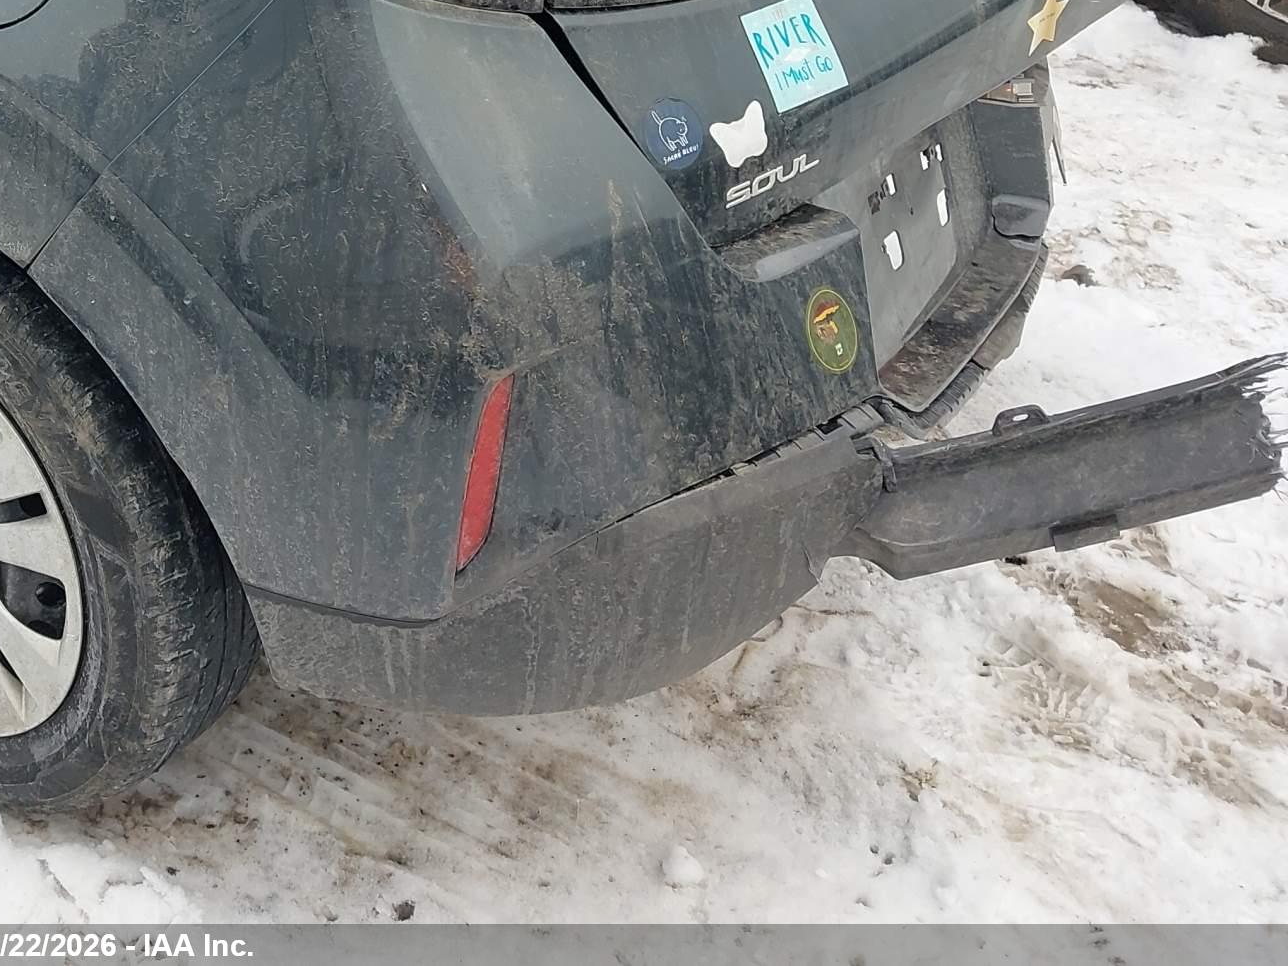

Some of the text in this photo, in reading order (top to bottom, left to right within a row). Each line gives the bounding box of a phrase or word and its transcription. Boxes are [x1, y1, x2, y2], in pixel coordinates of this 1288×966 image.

[752, 13, 826, 69] RIVER
[782, 58, 816, 88] Must
[725, 154, 820, 209] SOUL
